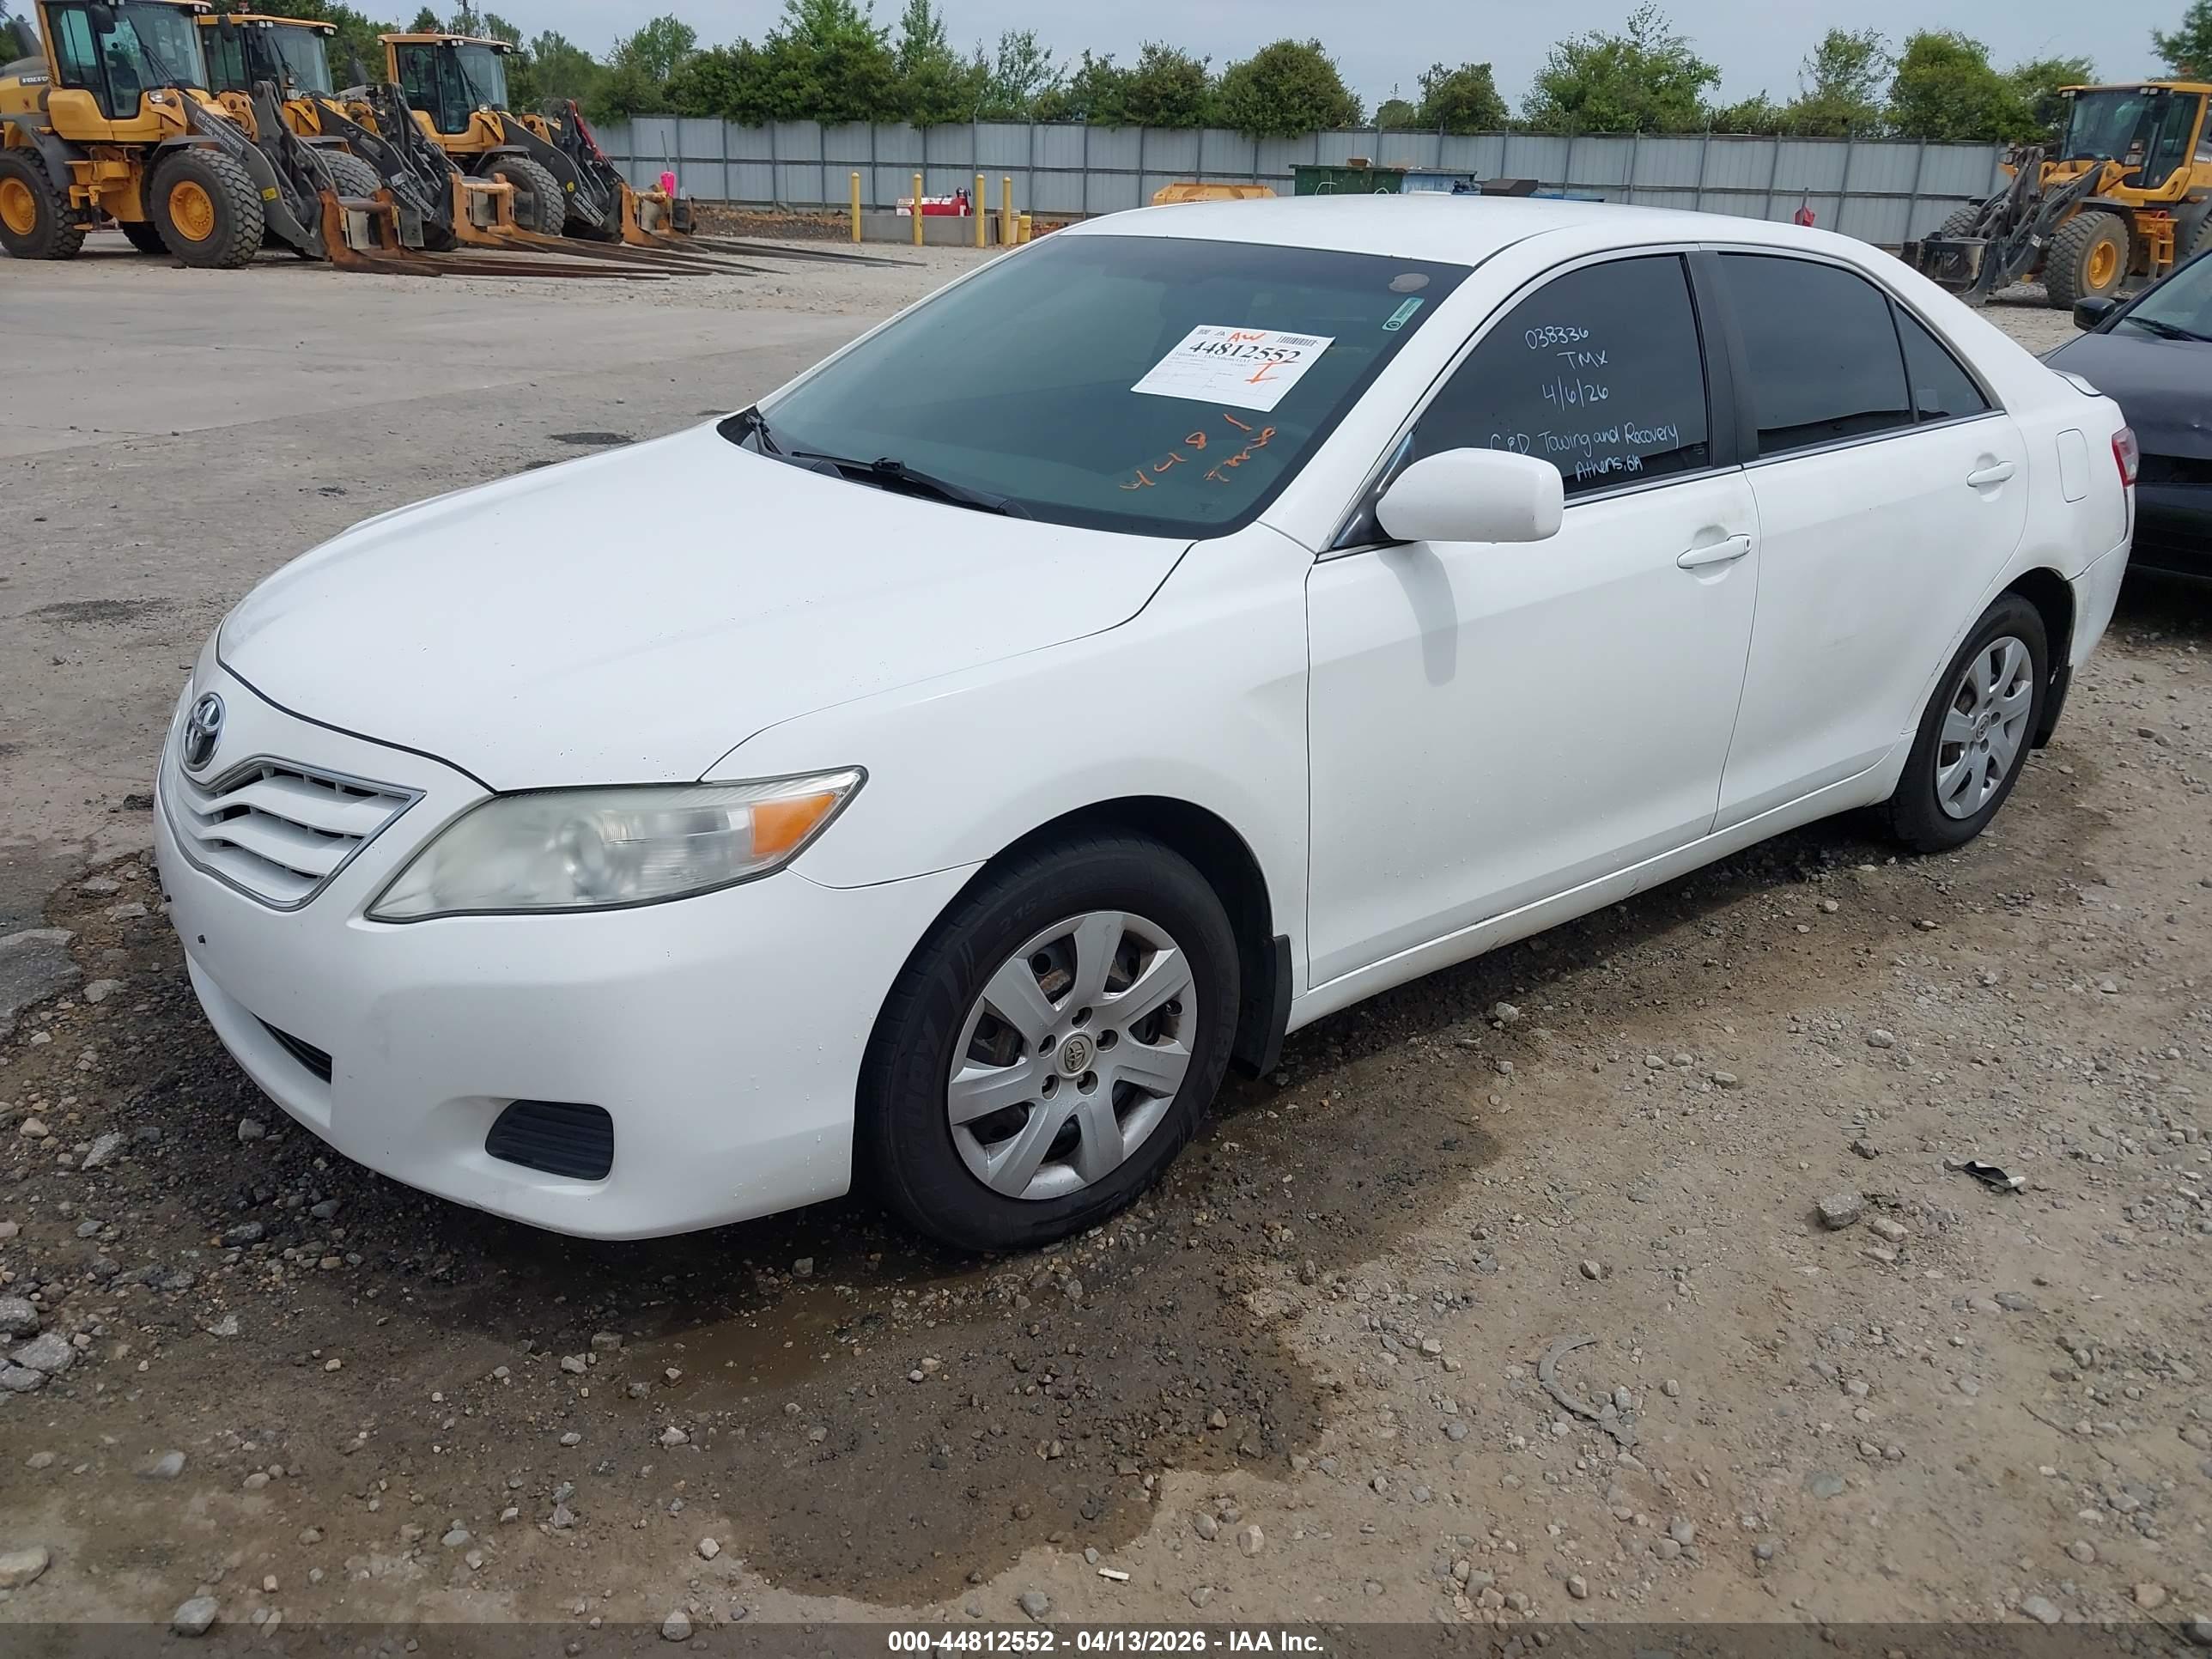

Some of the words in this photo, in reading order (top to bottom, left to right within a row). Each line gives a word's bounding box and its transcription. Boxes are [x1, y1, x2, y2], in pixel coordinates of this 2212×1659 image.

[1525, 325, 1589, 349] 038336
[1188, 339, 1301, 364] 44812552
[1556, 349, 1608, 370] TMX
[1541, 375, 1609, 412] 4/6/26
[1537, 430, 1592, 458] Towing
[1593, 425, 1620, 444] and
[1624, 422, 1679, 449] Recovery
